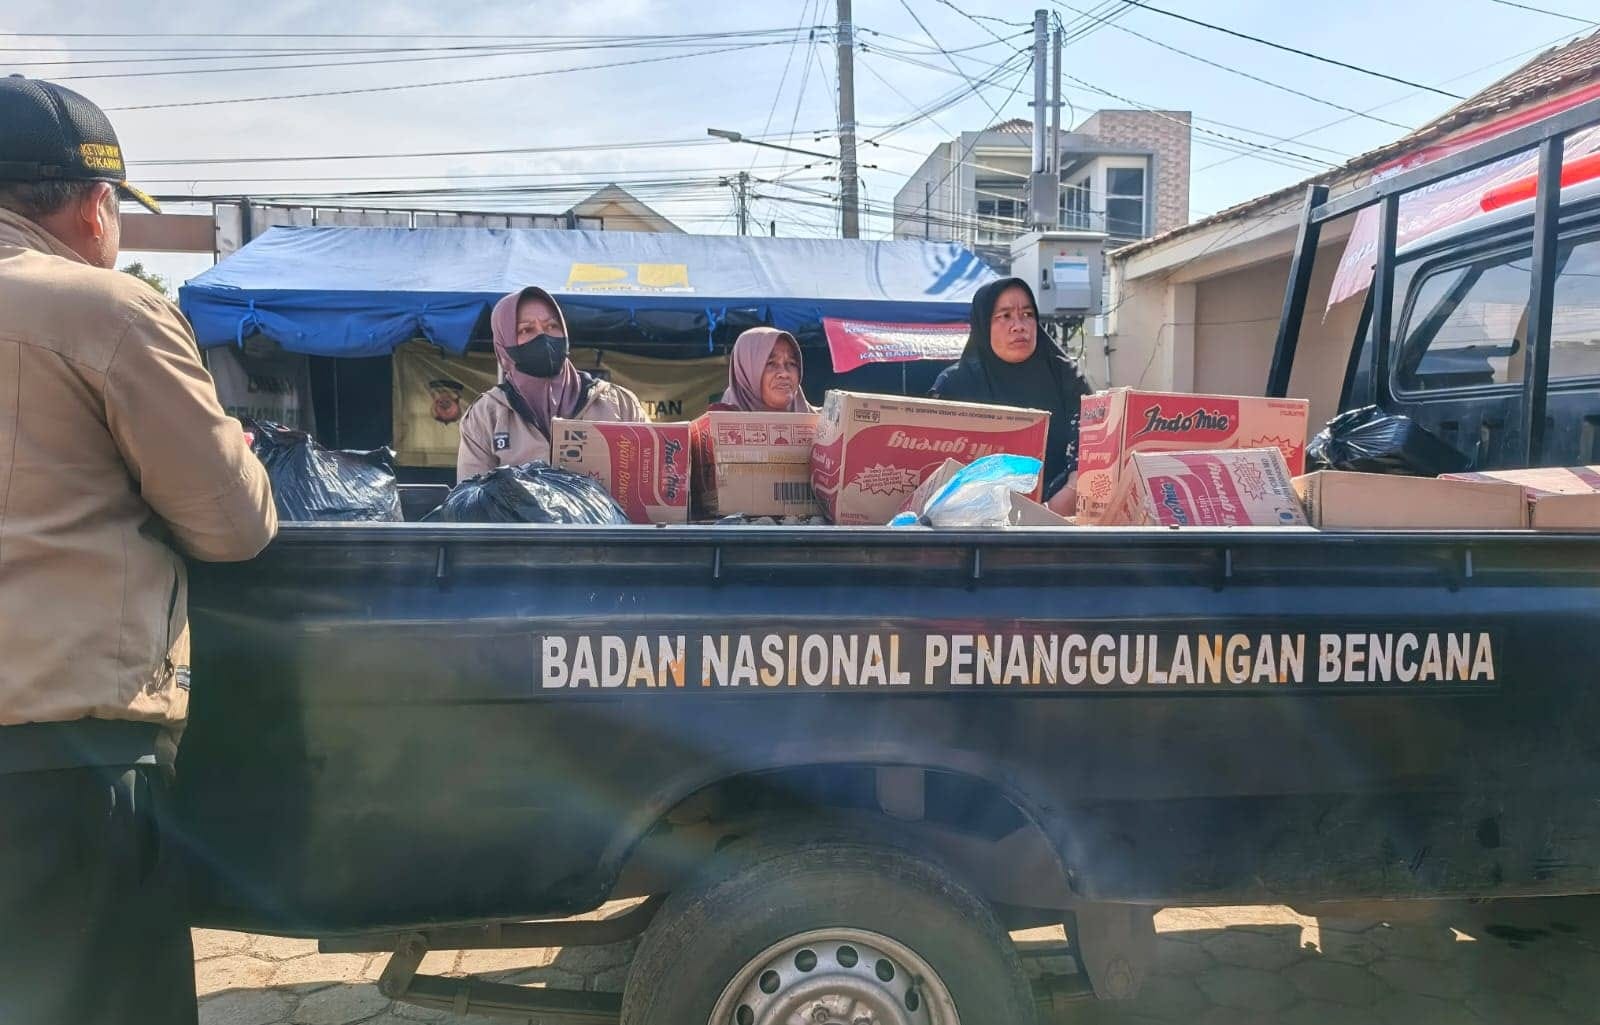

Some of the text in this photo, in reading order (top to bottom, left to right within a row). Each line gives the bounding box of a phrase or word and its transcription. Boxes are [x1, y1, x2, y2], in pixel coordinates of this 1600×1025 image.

[887, 430, 969, 454] goreng
[541, 632, 1495, 689] BADAN NASIONAL PENANGGULANGAN BENCANA
